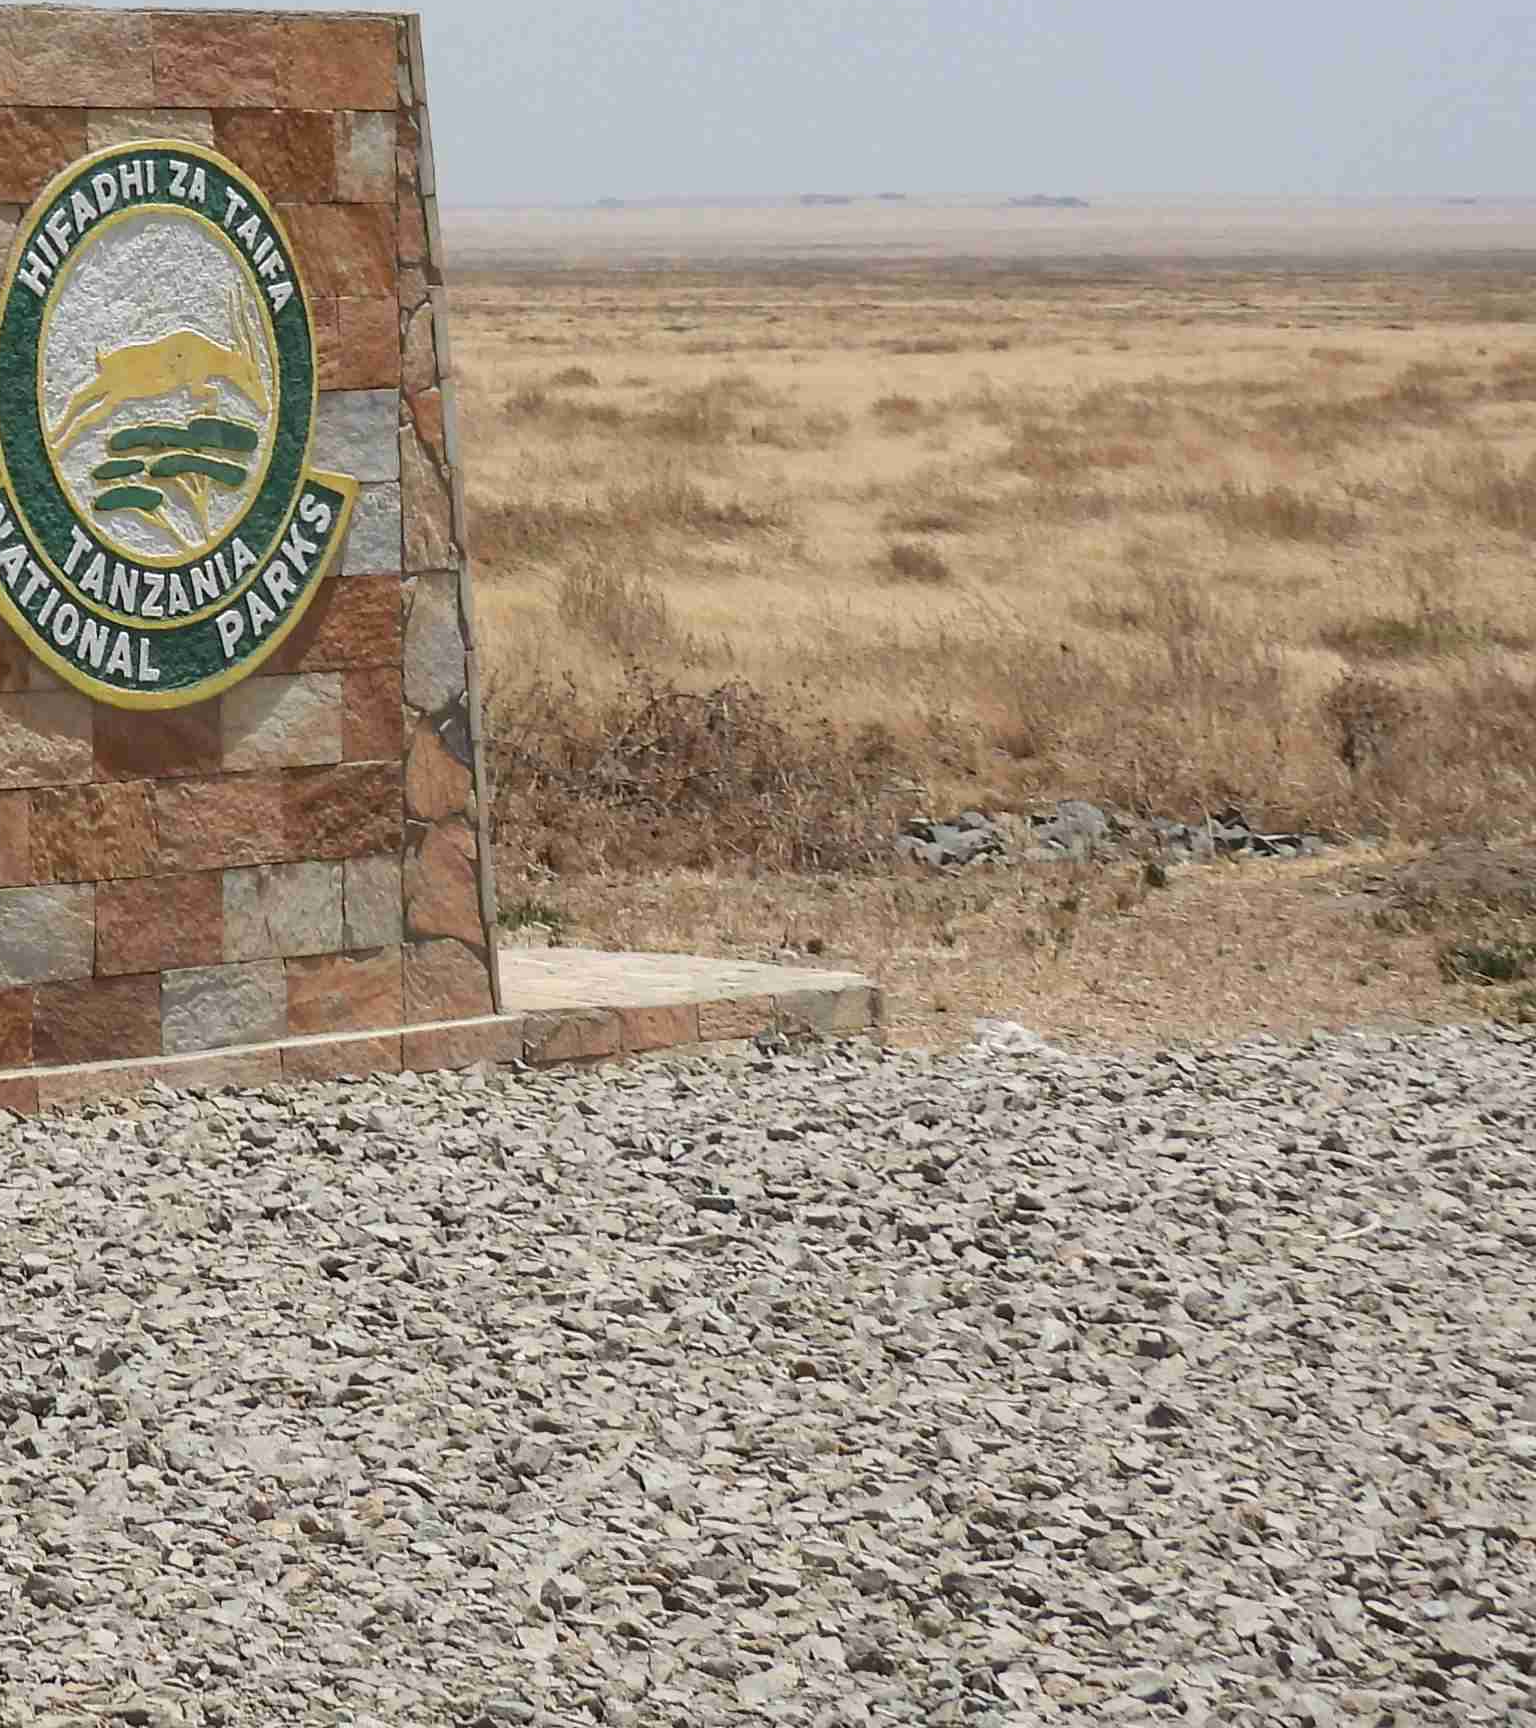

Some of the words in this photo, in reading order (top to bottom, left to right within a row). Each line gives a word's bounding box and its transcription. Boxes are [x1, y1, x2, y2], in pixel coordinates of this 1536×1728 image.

[19, 160, 157, 298] HIFADHI
[168, 160, 208, 204] ZA
[224, 186, 295, 313] TAIFA
[63, 526, 259, 618] TANZANIA
[215, 492, 332, 659] PARKS
